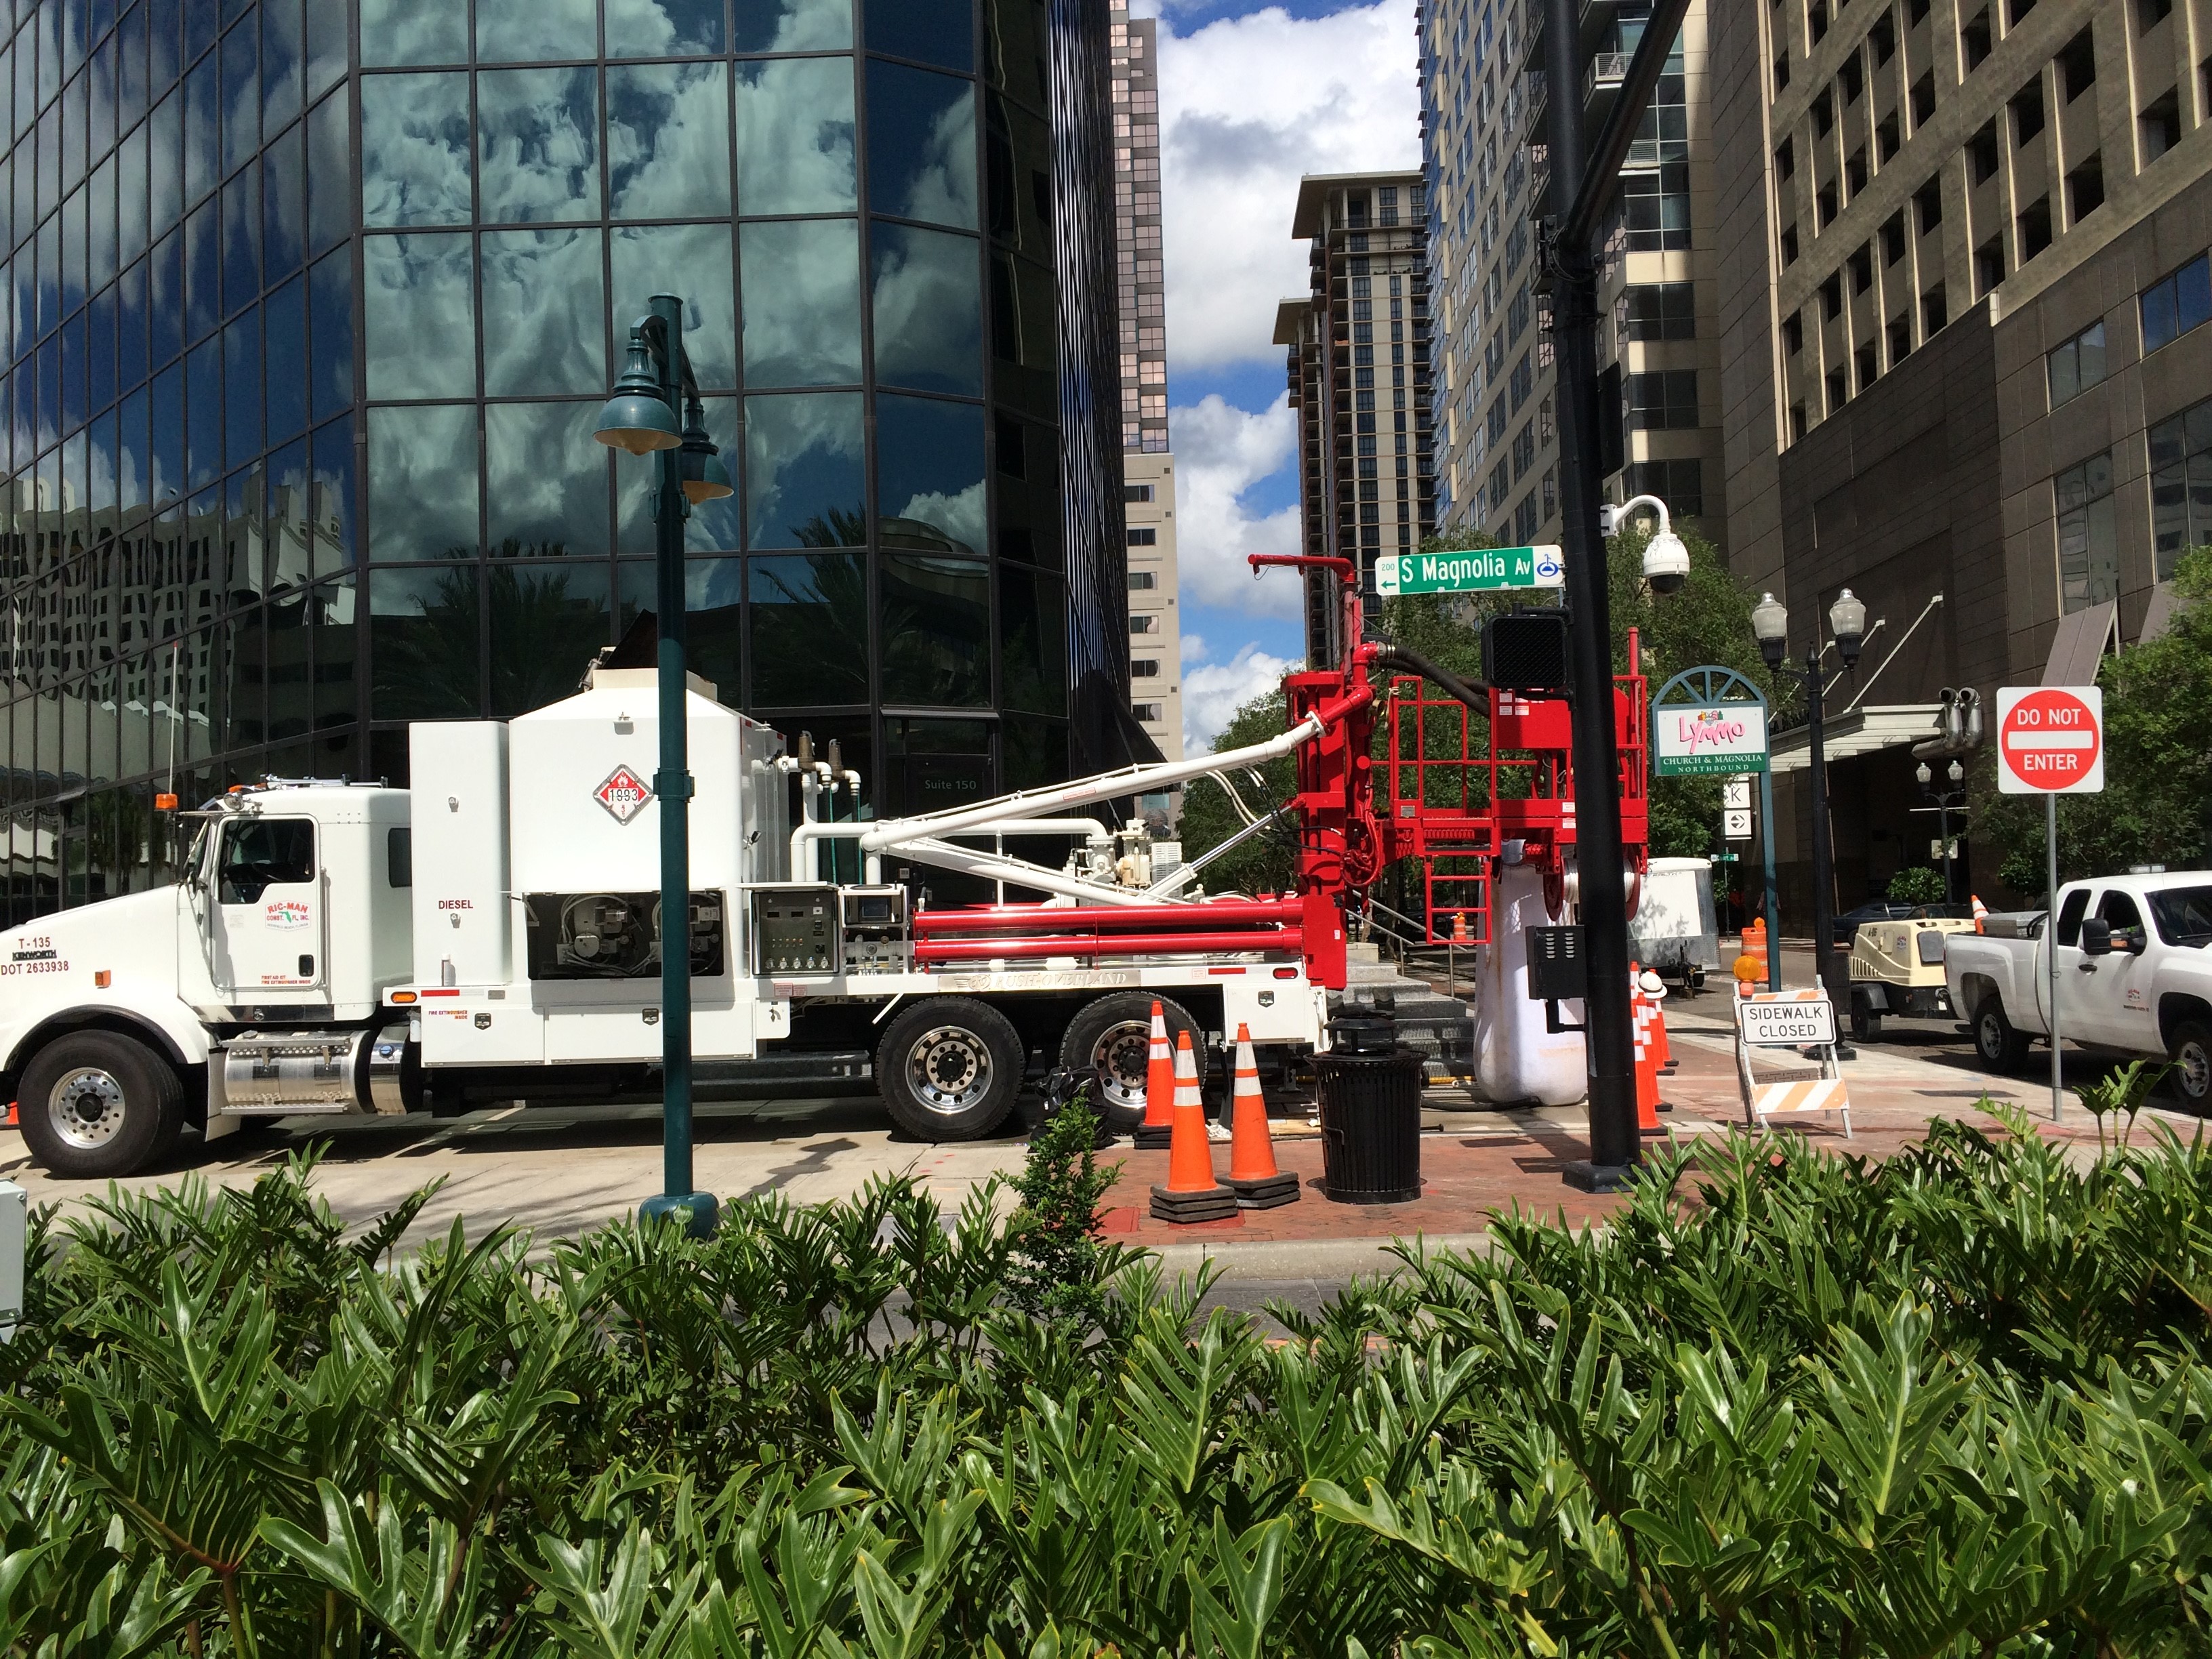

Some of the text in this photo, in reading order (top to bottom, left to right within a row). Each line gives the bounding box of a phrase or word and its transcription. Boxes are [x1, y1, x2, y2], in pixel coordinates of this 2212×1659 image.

[1401, 558, 1414, 583] S
[1422, 552, 1505, 588] Magnolia
[1515, 557, 1530, 575] Av
[2018, 708, 2081, 725] DO NOT
[1663, 756, 1701, 765] CHURCH
[1715, 754, 1762, 763] MAGNOLIA
[2024, 754, 2078, 771] ENTER
[1678, 764, 1749, 773] NORTHBOUND
[925, 779, 976, 790] Suite 150
[610, 789, 637, 801] 1993
[1731, 787, 1741, 802] K
[267, 902, 308, 914] RIC-MAN
[438, 899, 474, 909] DIESEL
[1, 960, 69, 975] DOT 2633938
[995, 972, 1127, 988] RUSH-OVERLAND
[1749, 1006, 1822, 1020] SIDEWALK
[1759, 1024, 1817, 1037] CLOSED
